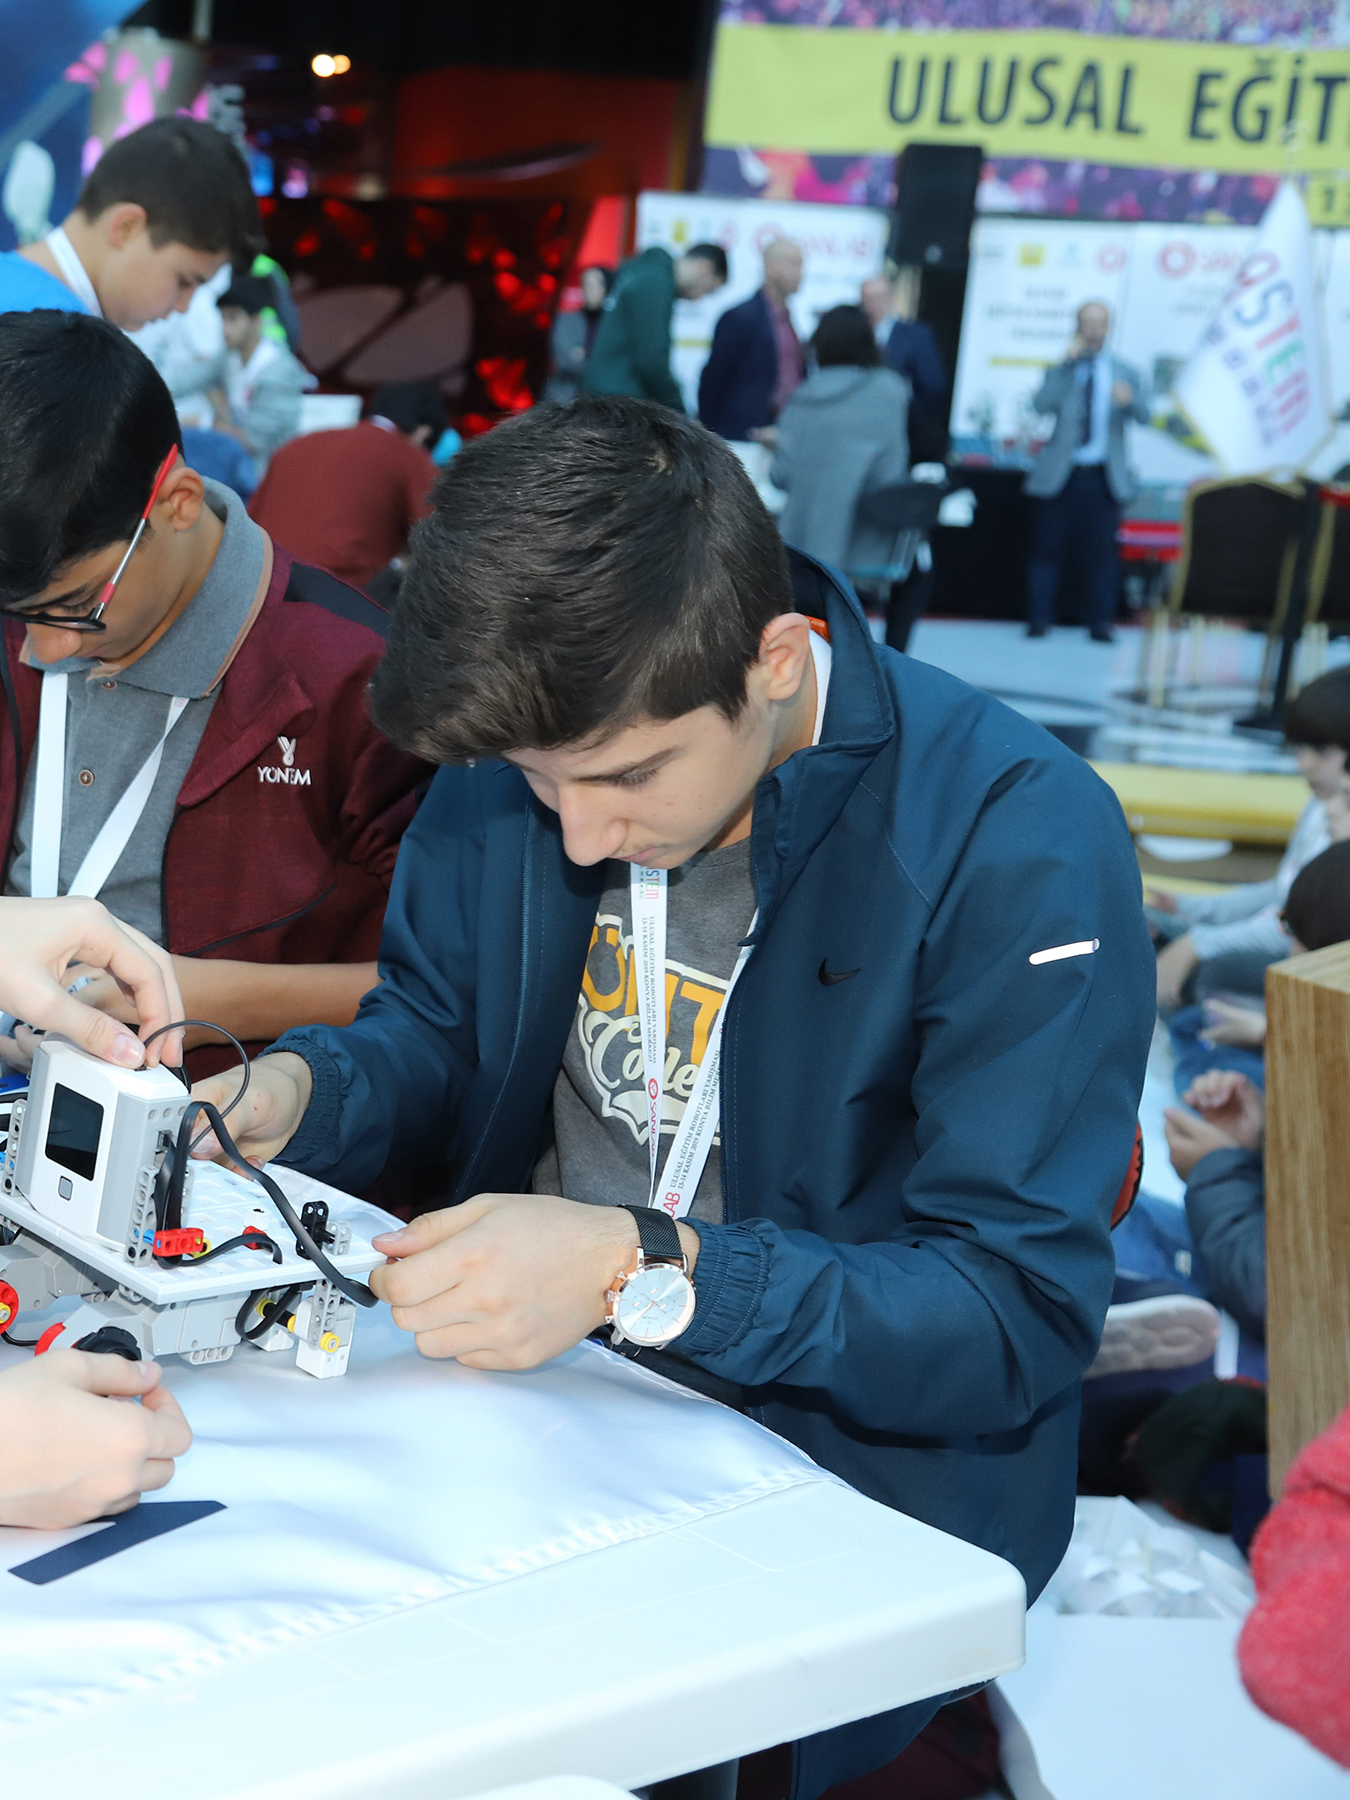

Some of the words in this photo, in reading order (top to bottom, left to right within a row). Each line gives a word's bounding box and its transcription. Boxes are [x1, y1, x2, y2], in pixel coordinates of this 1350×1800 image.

[887, 56, 1144, 136] ULUSAL
[1186, 57, 1350, 144] EĞİT
[645, 868, 660, 900] STEM
[691, 1138, 700, 1151] 2019
[696, 1111, 708, 1137] KONYA
[670, 1160, 683, 1188] ULUSAL
